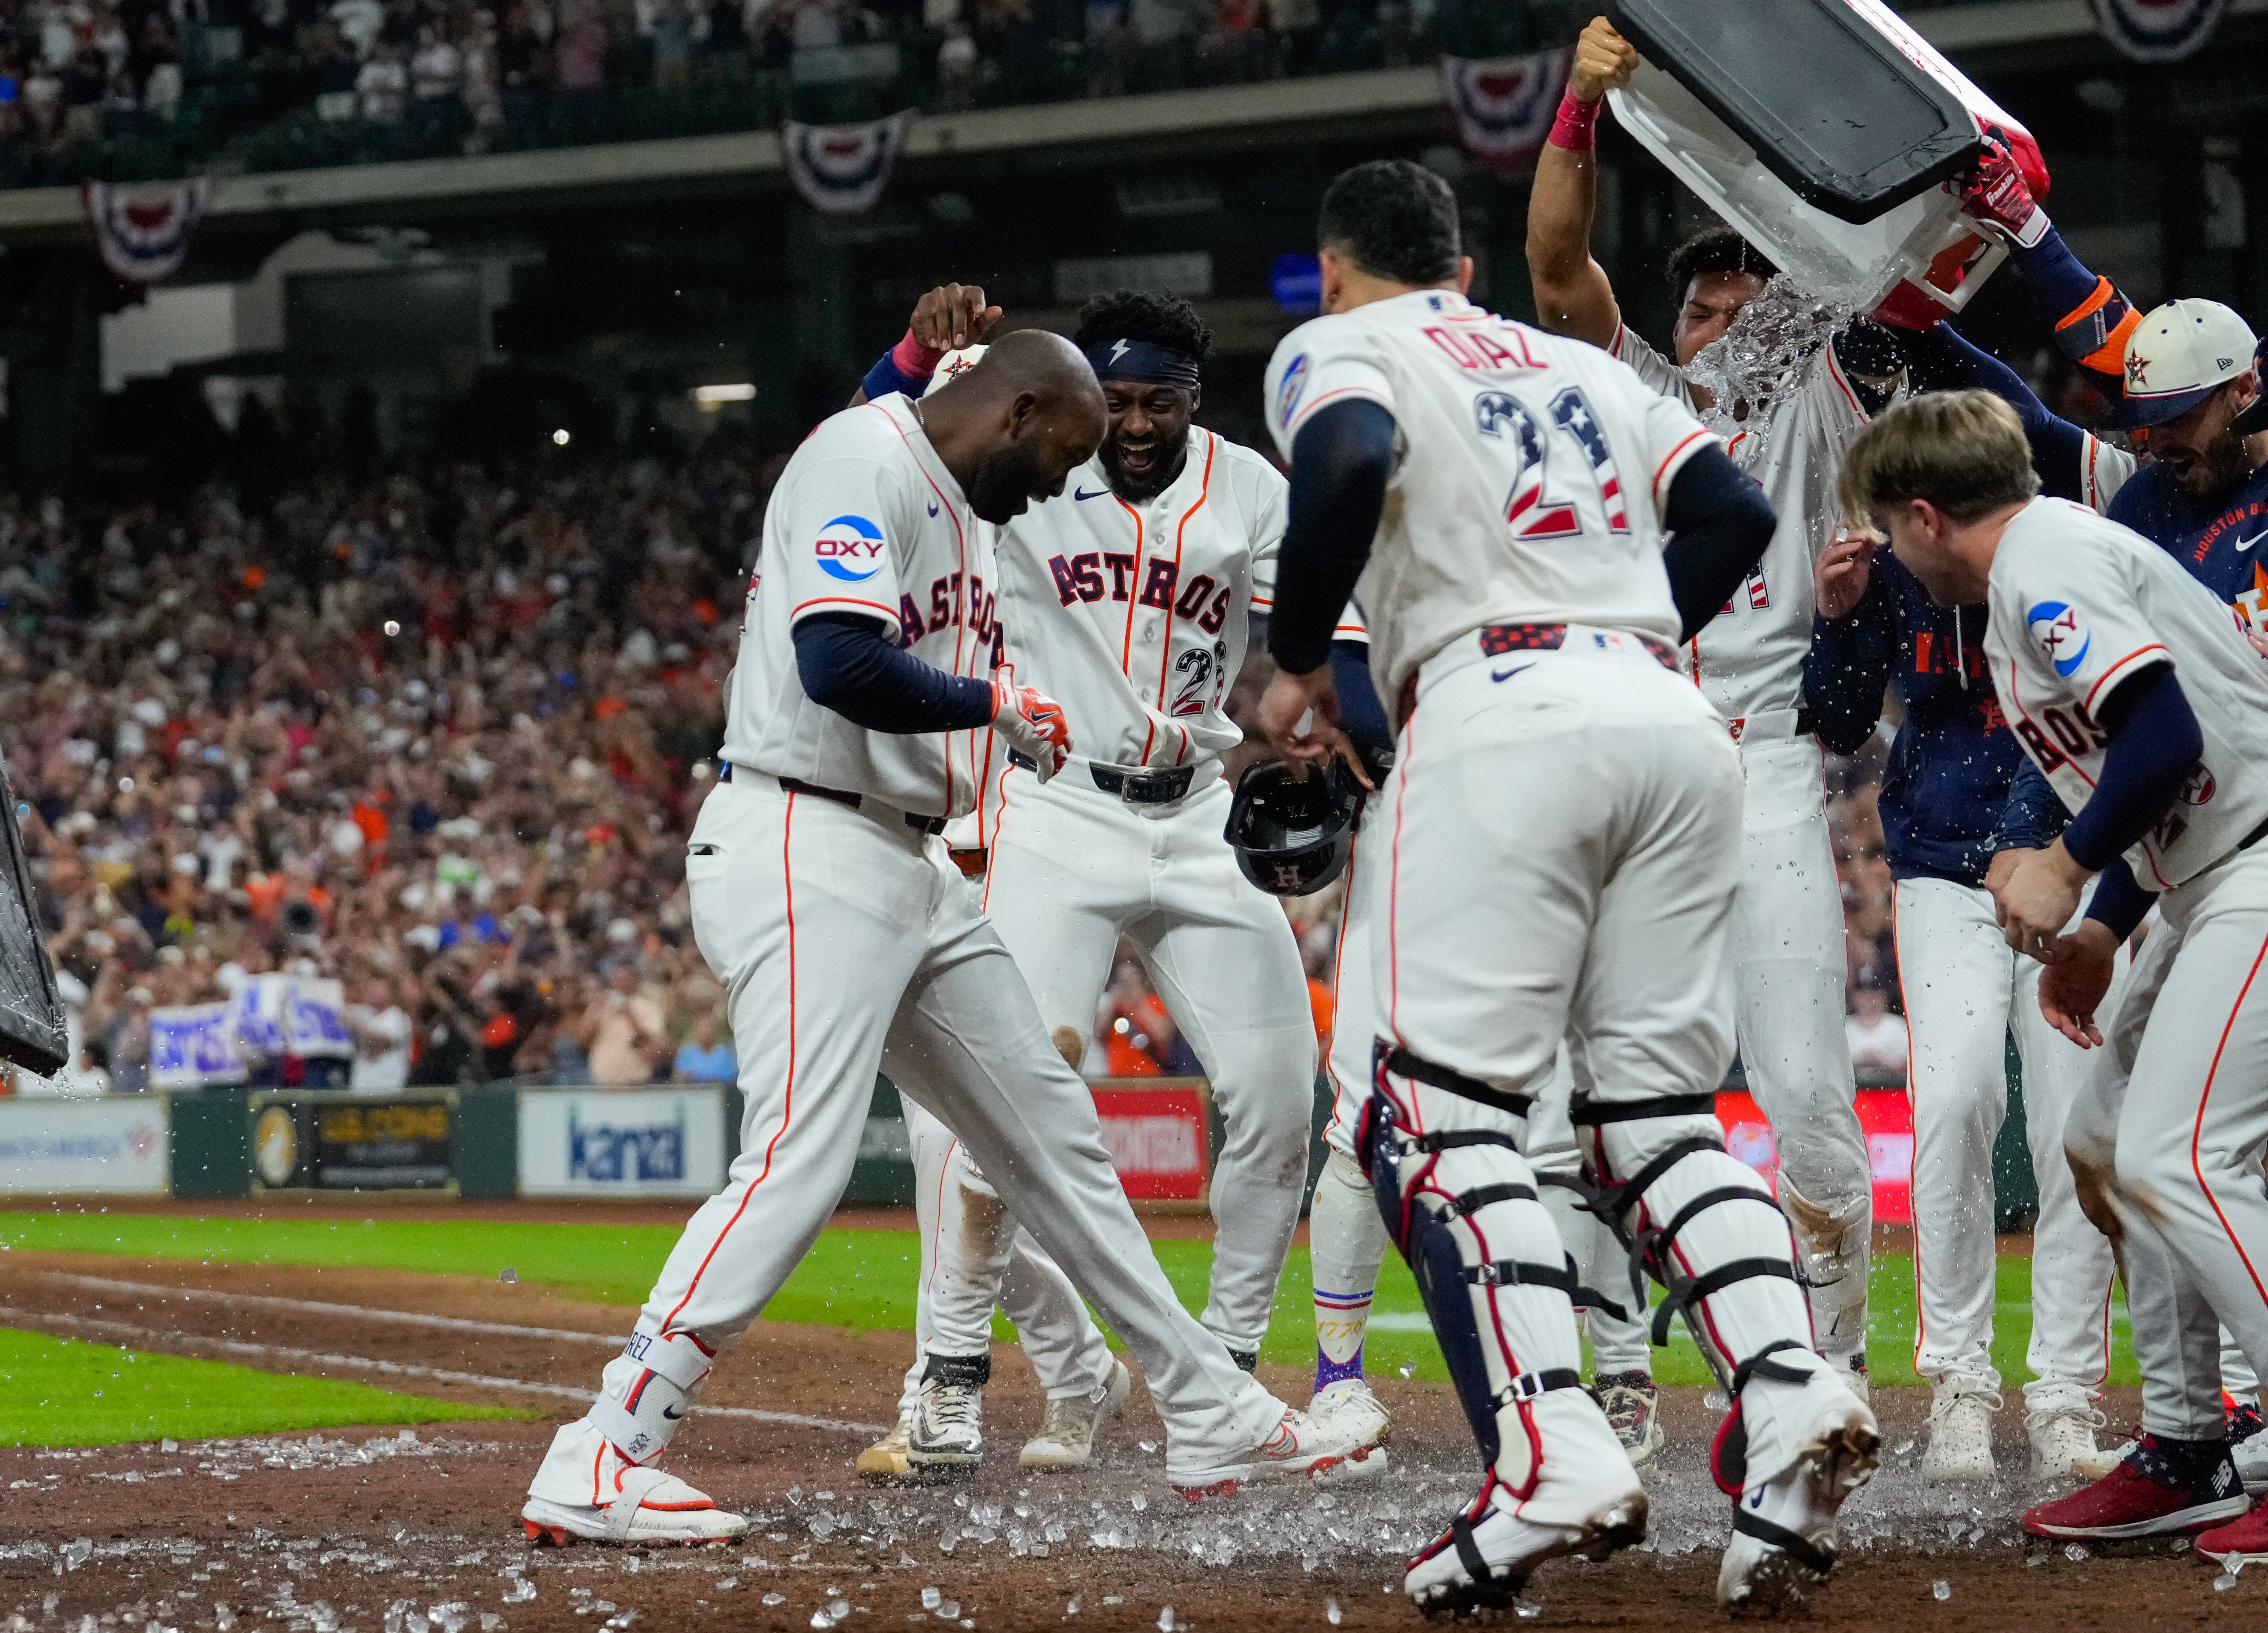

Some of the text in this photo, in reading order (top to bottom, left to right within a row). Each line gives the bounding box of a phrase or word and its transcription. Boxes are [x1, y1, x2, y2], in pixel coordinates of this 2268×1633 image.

[1474, 385, 1632, 541] 21
[815, 539, 884, 558] OXY
[2194, 502, 2268, 561] HOUSTON BA
[1048, 552, 1231, 635] ASTROS
[623, 1331, 653, 1362] REZ
